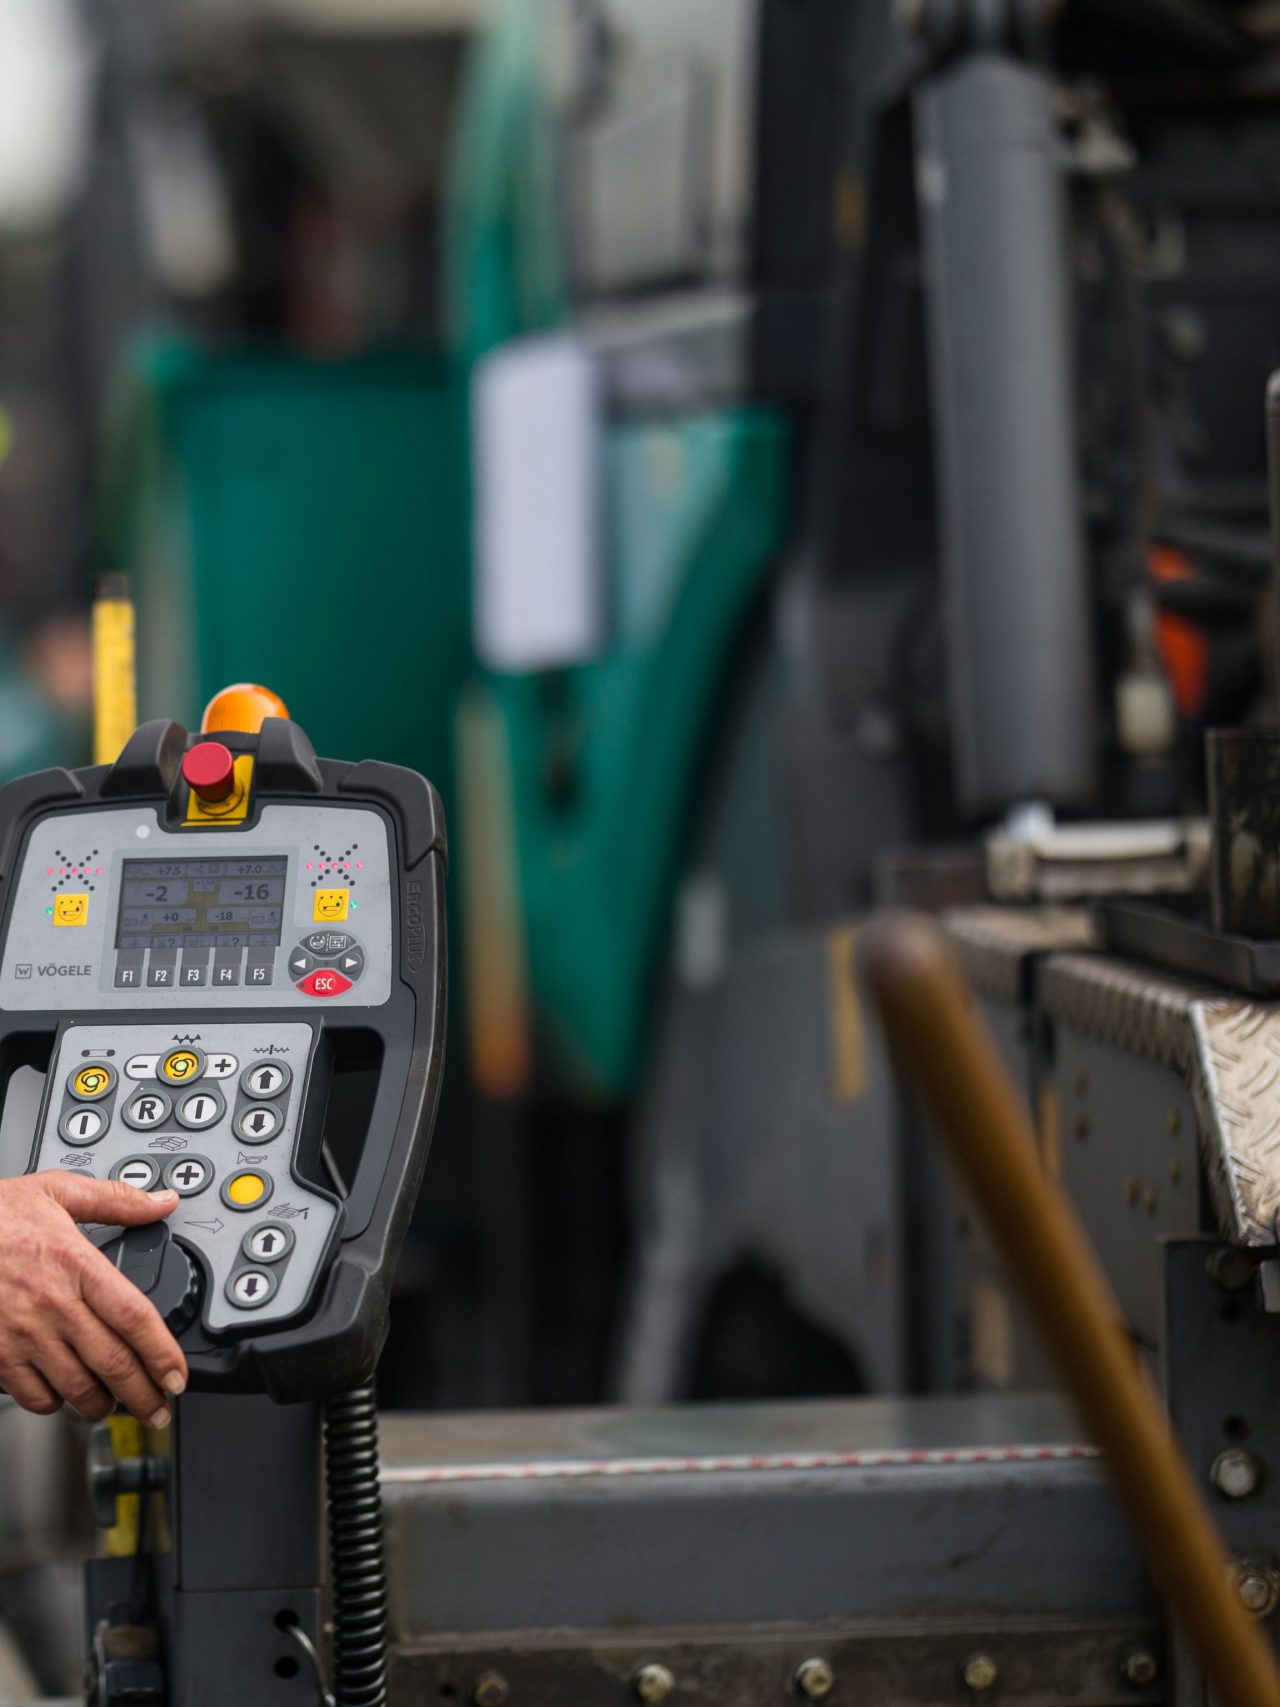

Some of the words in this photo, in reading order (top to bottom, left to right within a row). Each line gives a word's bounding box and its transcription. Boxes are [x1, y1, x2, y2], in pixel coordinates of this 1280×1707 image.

[237, 864, 262, 874] +7.0
[146, 885, 169, 902] -2
[234, 883, 270, 900] -16
[215, 911, 234, 921] -18
[37, 963, 92, 977] VÖGELE
[122, 970, 134, 982] F1
[154, 970, 167, 982] F2
[187, 969, 200, 981] F3
[220, 969, 232, 981] F4
[253, 968, 265, 980] F5
[315, 978, 334, 990] ESC
[138, 1100, 157, 1120] R
